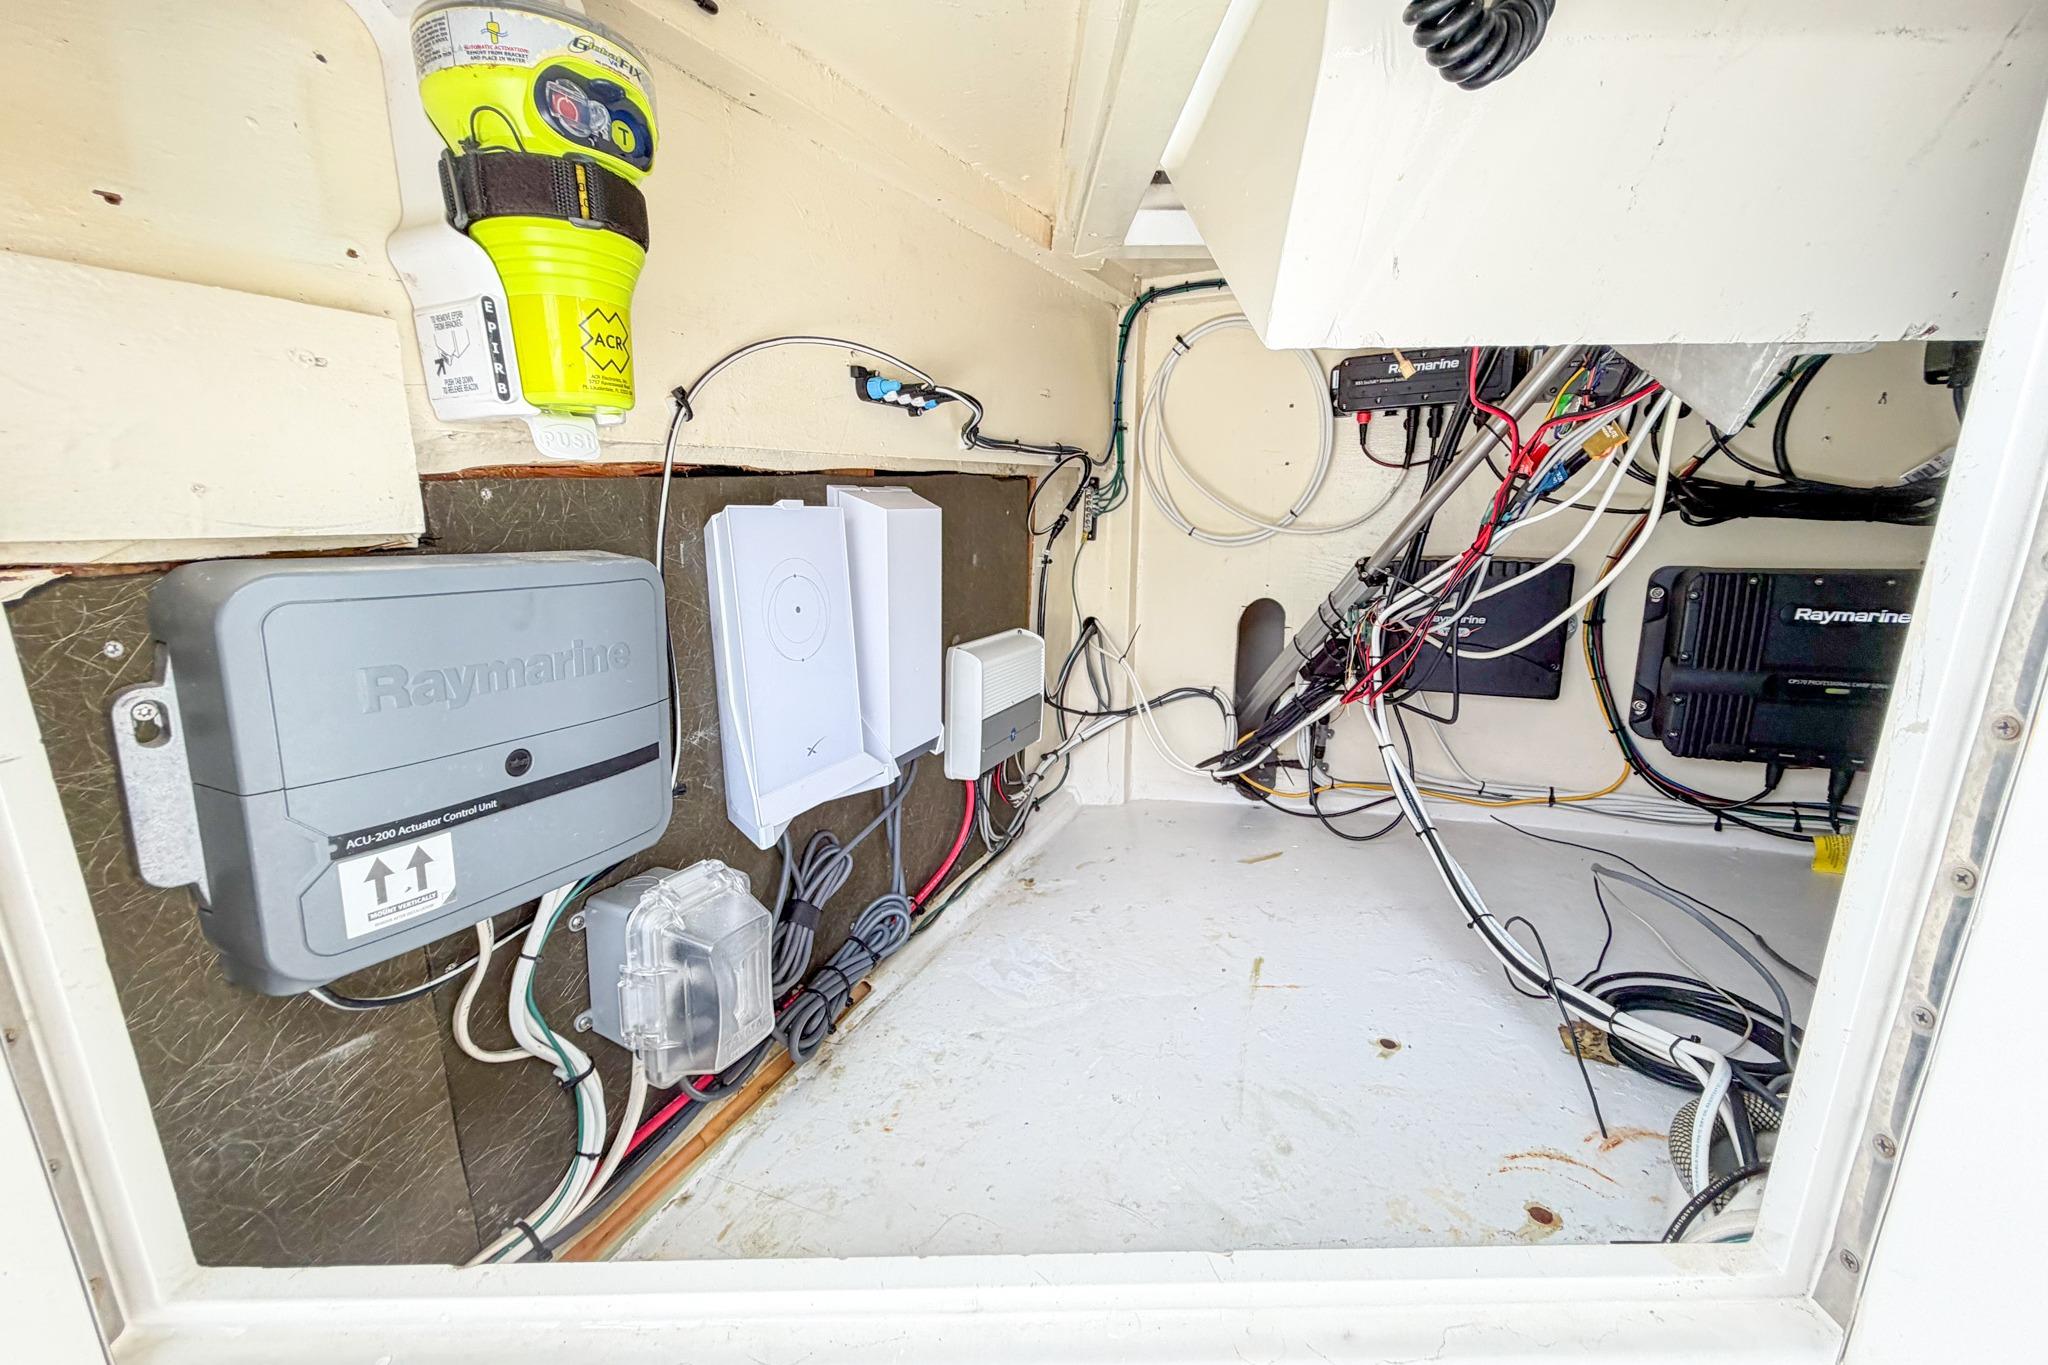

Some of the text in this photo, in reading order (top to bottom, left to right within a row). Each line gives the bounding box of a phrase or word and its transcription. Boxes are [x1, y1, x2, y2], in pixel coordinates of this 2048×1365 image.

[618, 126, 629, 146] T
[483, 300, 508, 395] EPIRB
[594, 332, 624, 352] ACR
[1388, 357, 1460, 375] Rmarine
[1793, 607, 1912, 625] Raymarine
[359, 637, 632, 714] Raymarine
[346, 799, 498, 850] ACU-200 Actuator Control Unit
[370, 892, 438, 921] MOUNT VERTICALLY
